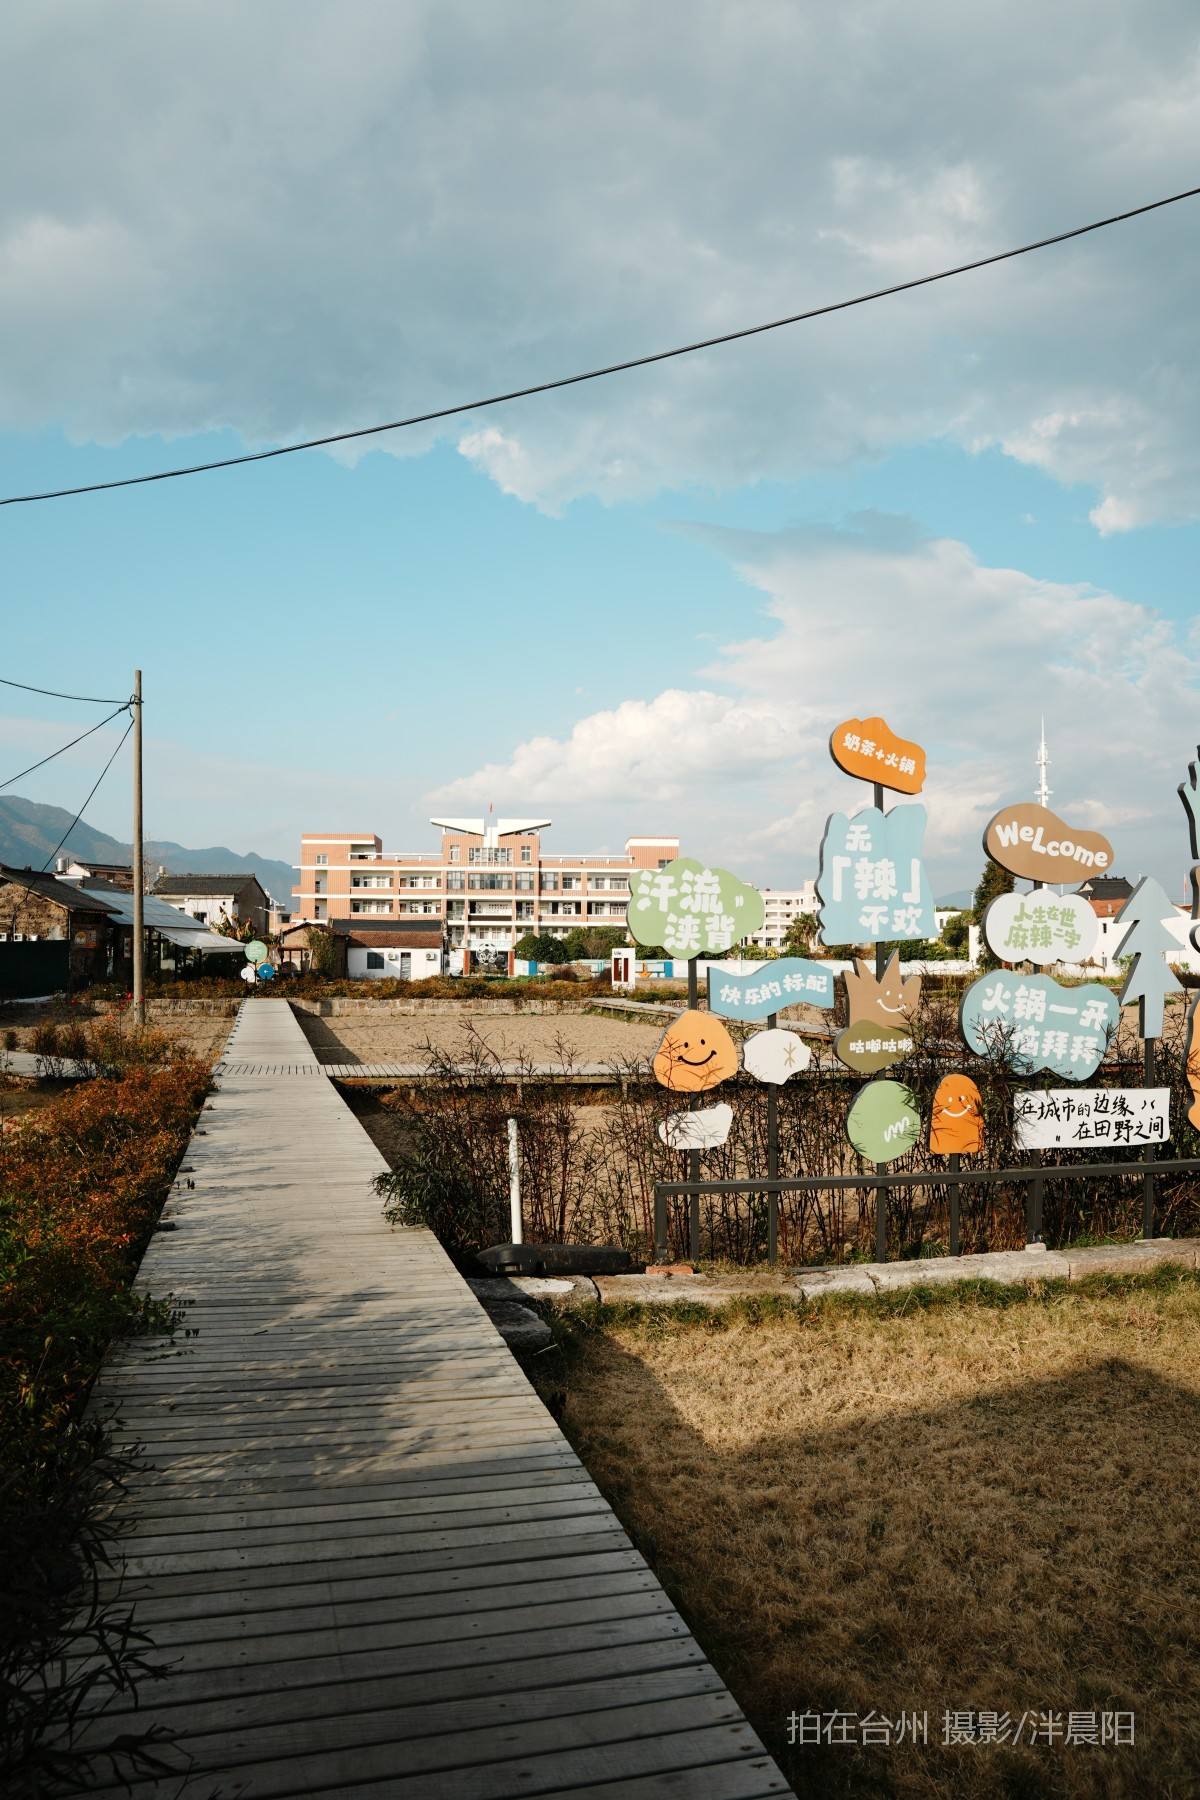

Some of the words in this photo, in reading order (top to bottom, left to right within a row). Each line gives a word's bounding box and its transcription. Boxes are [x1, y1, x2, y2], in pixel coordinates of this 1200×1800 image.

[842, 732, 916, 776] 奶茶+火锅
[845, 824, 872, 852] 无
[637, 868, 724, 914] 汗流
[858, 905, 923, 936] 不欢
[1013, 902, 1077, 928] 人生在世
[664, 912, 736, 950] 浃背
[1003, 923, 1082, 950] 麻辣二字
[719, 973, 828, 1006] 快乐的标配
[981, 982, 1109, 1031] 火锅一开
[1020, 1092, 1135, 1122] 在城市的边缘
[1072, 1116, 1164, 1144] 在田野之间
